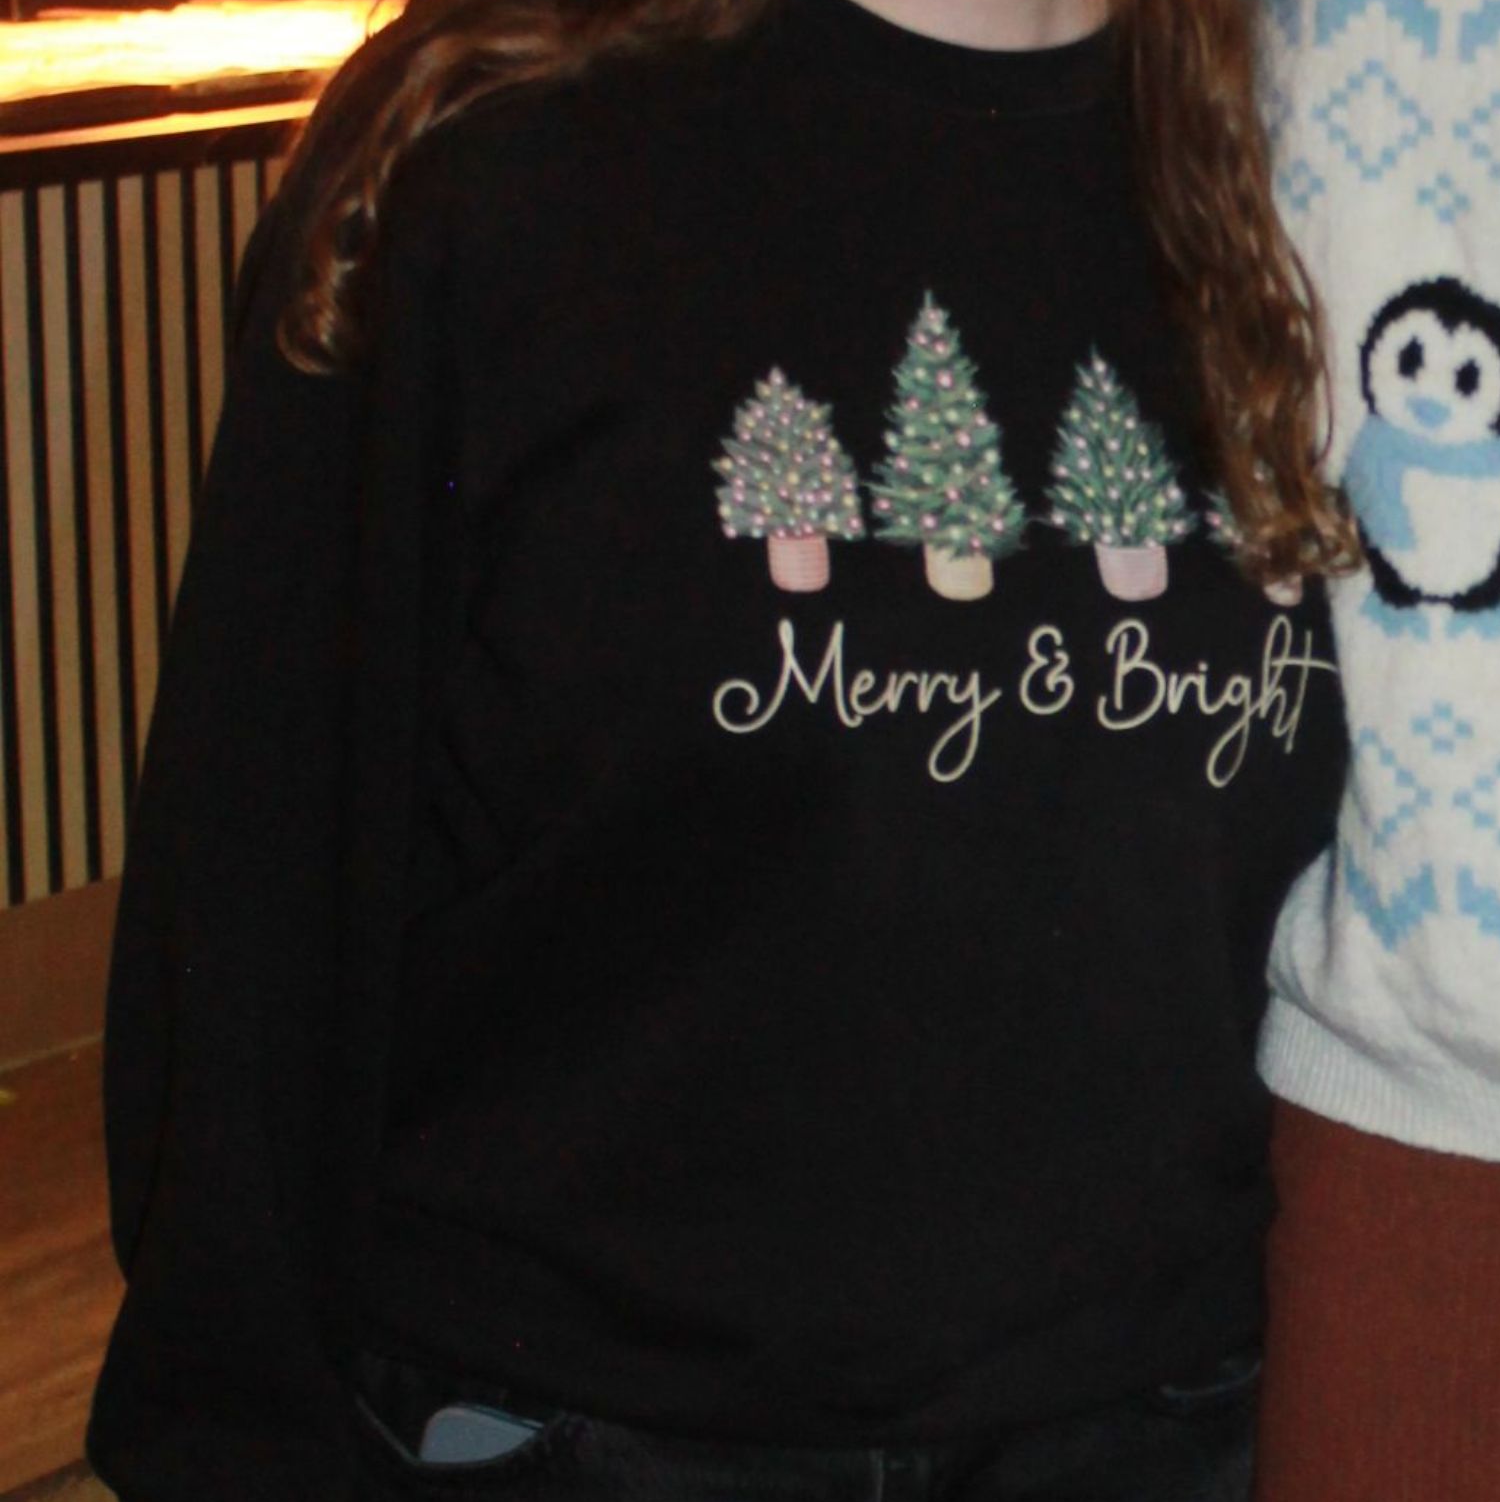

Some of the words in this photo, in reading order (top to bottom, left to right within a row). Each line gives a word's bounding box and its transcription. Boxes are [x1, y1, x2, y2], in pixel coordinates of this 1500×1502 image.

[712, 617, 1003, 784] Merry
[1018, 625, 1075, 716] &
[1096, 614, 1338, 789] Bright
